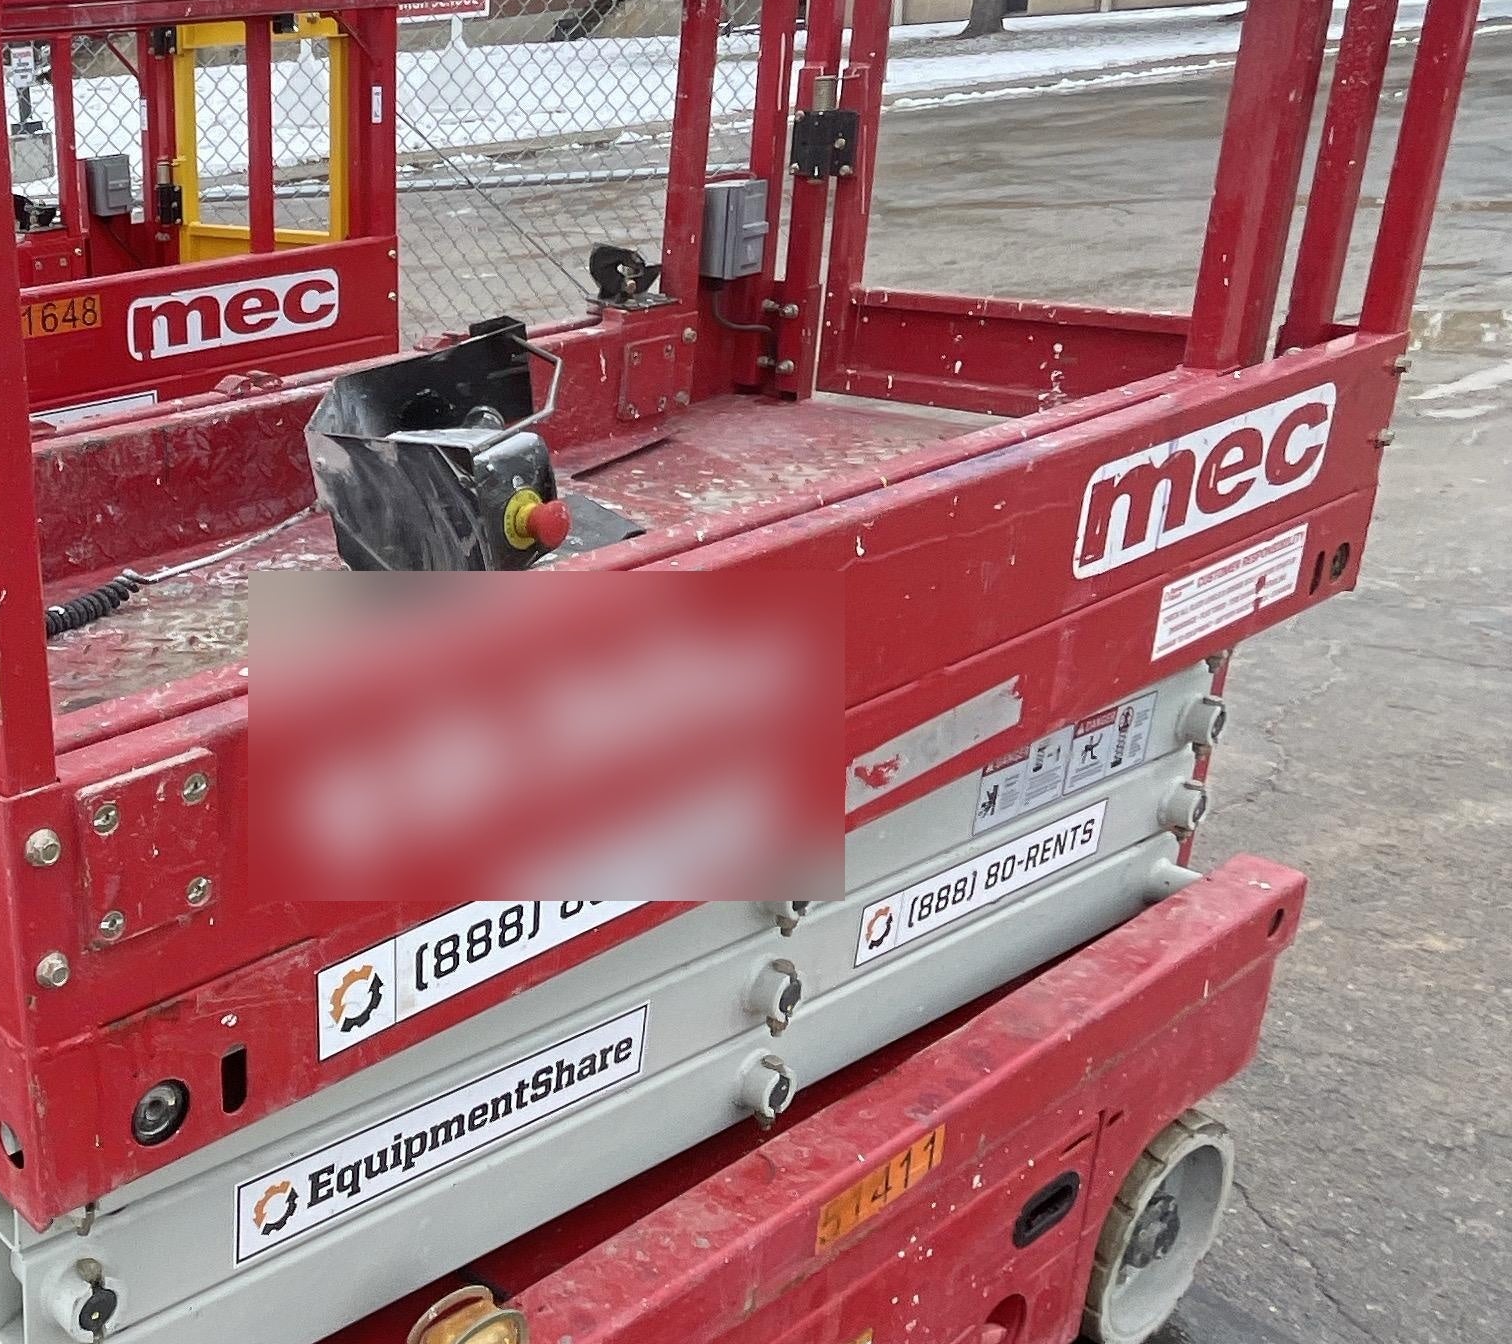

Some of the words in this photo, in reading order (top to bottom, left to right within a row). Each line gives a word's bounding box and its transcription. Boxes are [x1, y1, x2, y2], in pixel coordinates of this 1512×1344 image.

[22, 296, 98, 336] 1648
[133, 278, 336, 356] mec
[1078, 402, 1329, 569] mec
[908, 870, 978, 928] (888)
[984, 817, 1096, 891] 80-RENTS
[414, 901, 541, 992] (888)
[306, 1035, 633, 1210] EquipmentShare
